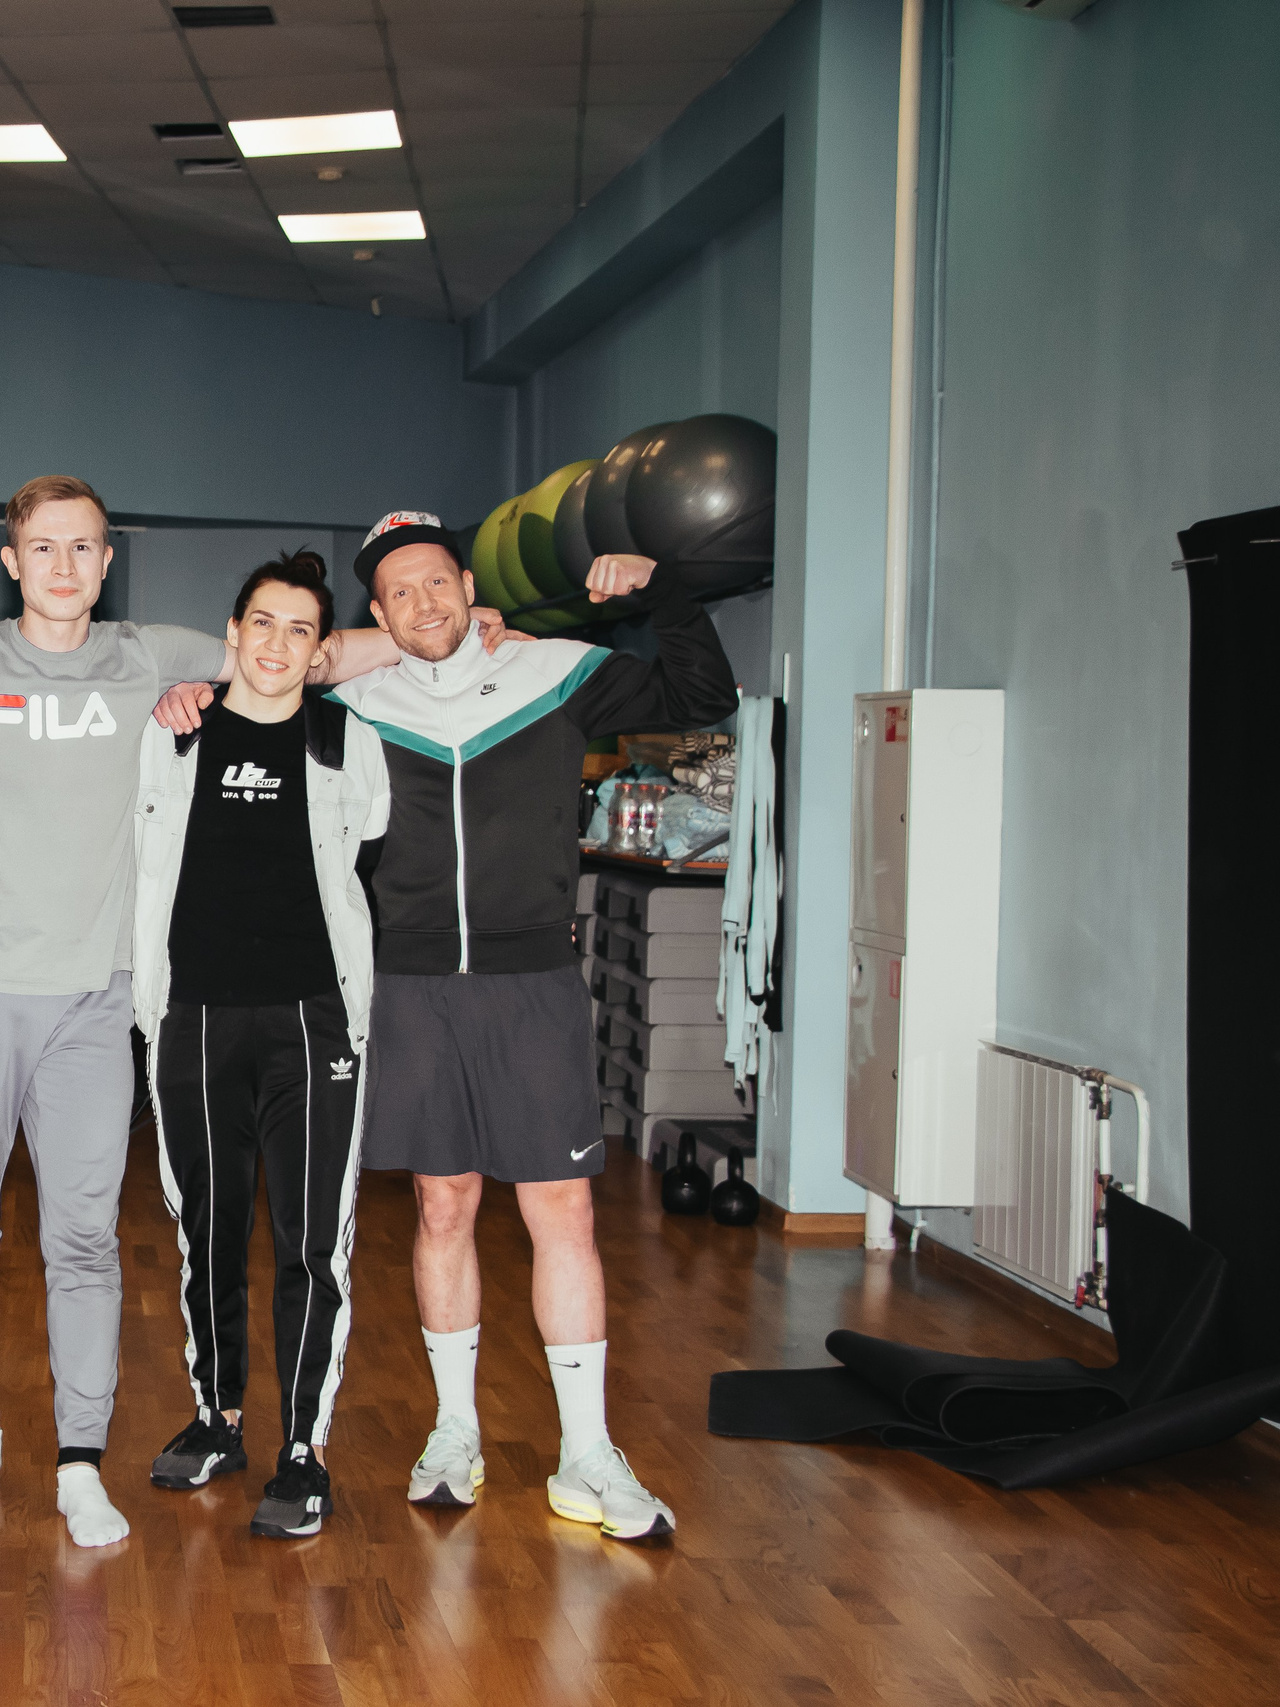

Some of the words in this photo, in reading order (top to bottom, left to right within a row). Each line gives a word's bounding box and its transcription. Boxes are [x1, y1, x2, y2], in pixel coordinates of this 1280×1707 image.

[483, 683, 497, 691] NIKE
[222, 791, 240, 799] UFA
[331, 1072, 352, 1080] adidas
